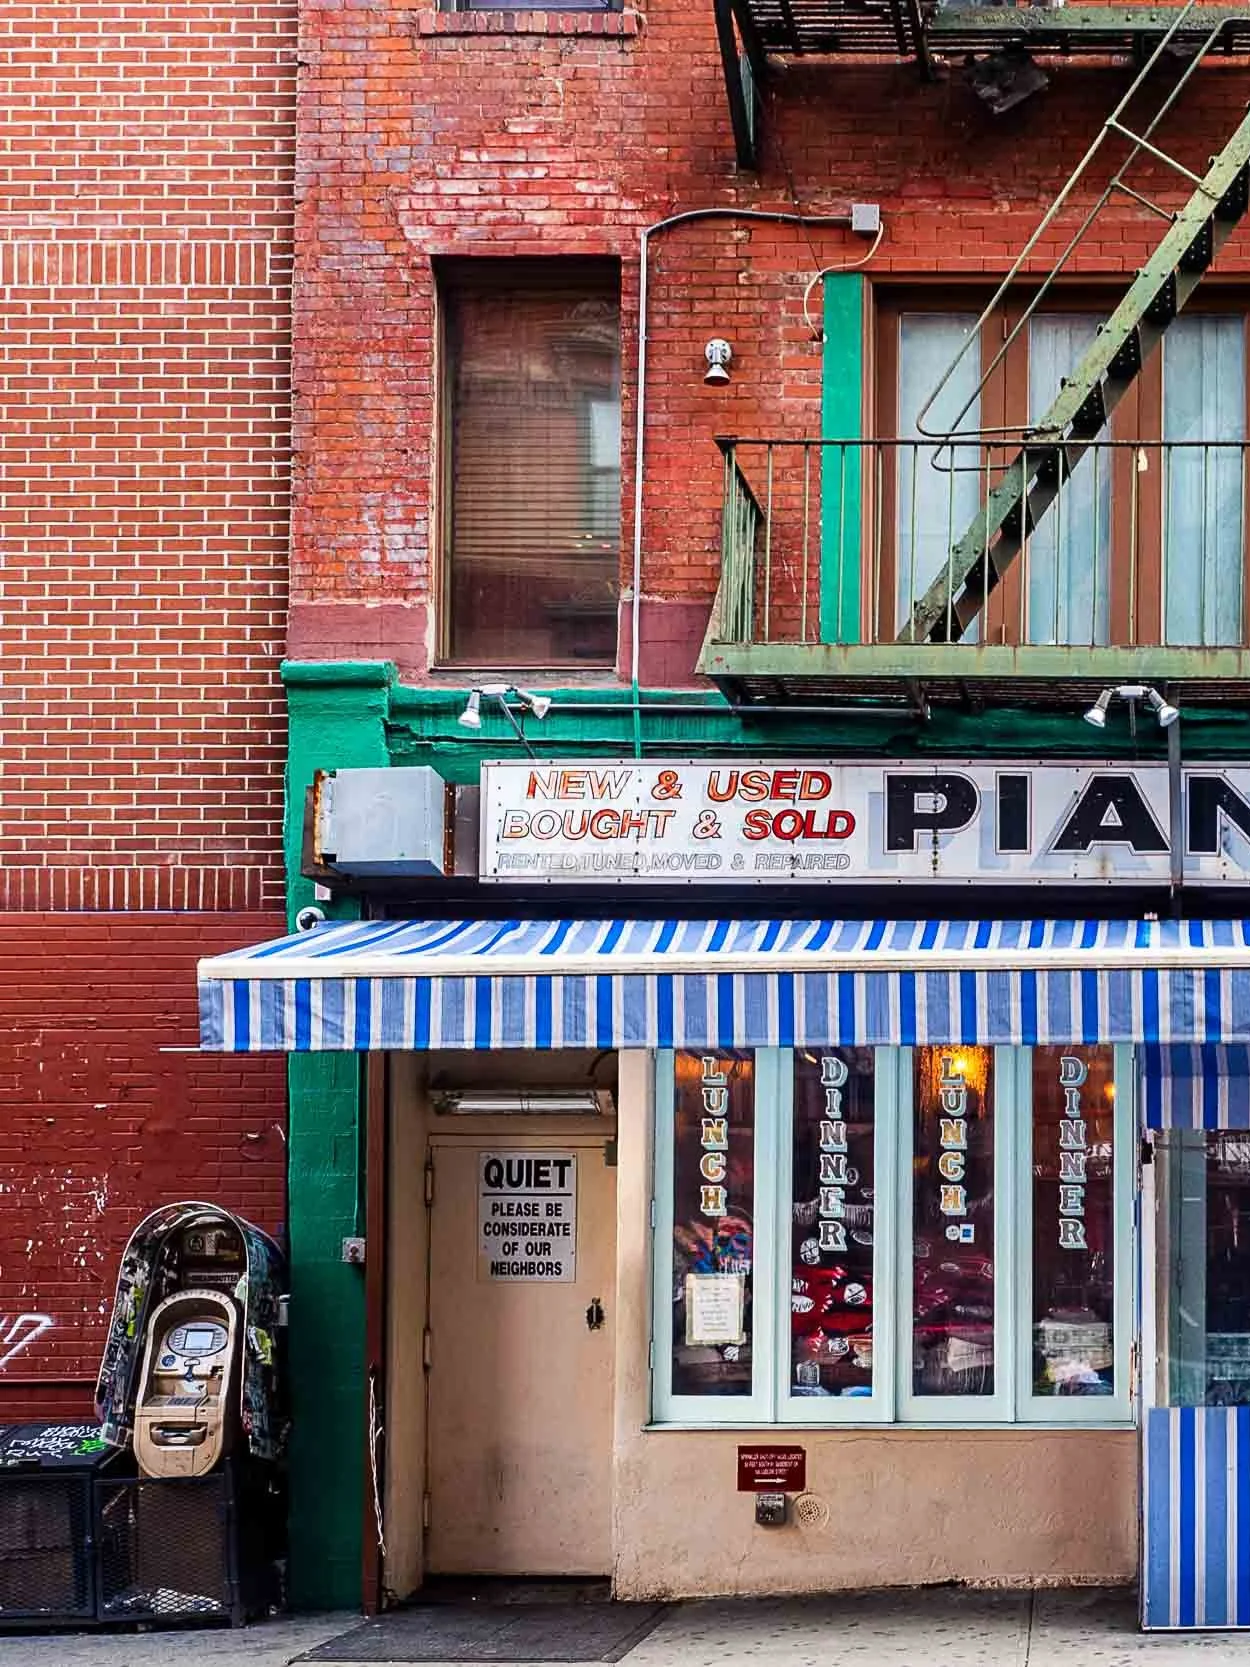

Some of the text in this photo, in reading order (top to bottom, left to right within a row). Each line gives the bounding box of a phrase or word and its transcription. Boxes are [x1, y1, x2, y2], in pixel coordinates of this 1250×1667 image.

[525, 770, 832, 801] NEW & USED
[501, 809, 856, 839] BOUGHT & SOLD
[731, 853, 746, 871] &
[754, 852, 851, 871] REPAIRED
[700, 1056, 729, 1216] LUNCH
[939, 1056, 967, 1216] LUNCH
[820, 1056, 848, 1251] DINNER
[1060, 1056, 1088, 1249] DINNER
[484, 1158, 571, 1189] QUIET
[491, 1202, 562, 1217] PLEASE BE
[483, 1222, 571, 1237] CONSIDERATE
[502, 1242, 551, 1256] OF OUR
[490, 1261, 562, 1276] NEIGHBORS
